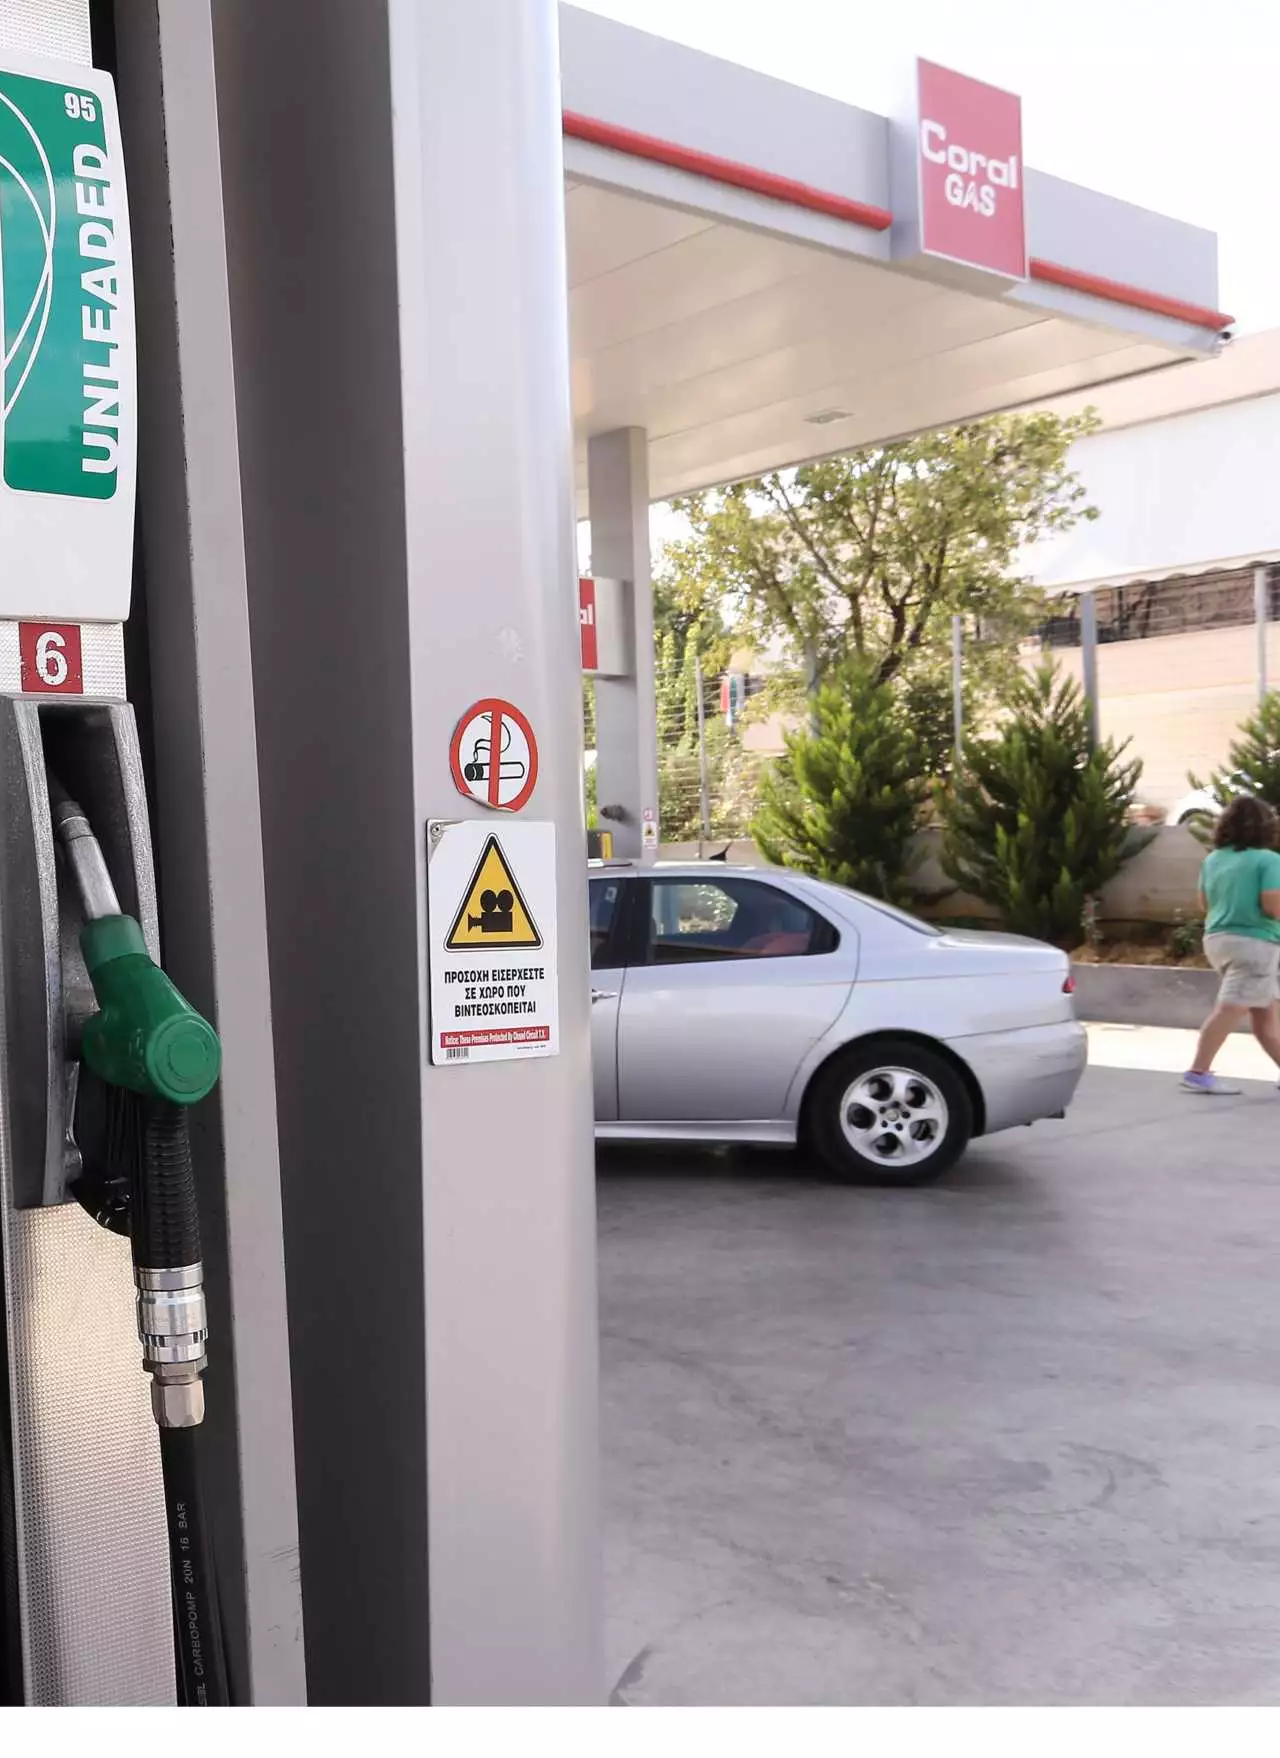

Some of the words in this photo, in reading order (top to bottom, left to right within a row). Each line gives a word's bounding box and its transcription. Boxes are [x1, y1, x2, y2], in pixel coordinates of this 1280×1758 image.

[64, 92, 96, 122] 95
[921, 119, 1018, 189] Coral
[945, 173, 995, 217] GAS
[72, 144, 119, 474] UNLEADED
[36, 632, 68, 685] 6
[444, 970, 489, 984] ΠΡΟΣΟΧΗ
[491, 968, 545, 981] ΕΙΣΕΡΧΕΣΤΕ
[465, 987, 476, 1000] ΣΕ
[479, 986, 504, 999] ΧΩΡΟ
[507, 985, 526, 997] ΠΟΥ
[454, 1001, 536, 1017] ΒΙΝΤΕΟΣΚΟΠΕΙΤΑΙ
[176, 1503, 188, 1528] BAR
[184, 1559, 194, 1584] 20N
[186, 1591, 204, 1676] CARBOPOMP
